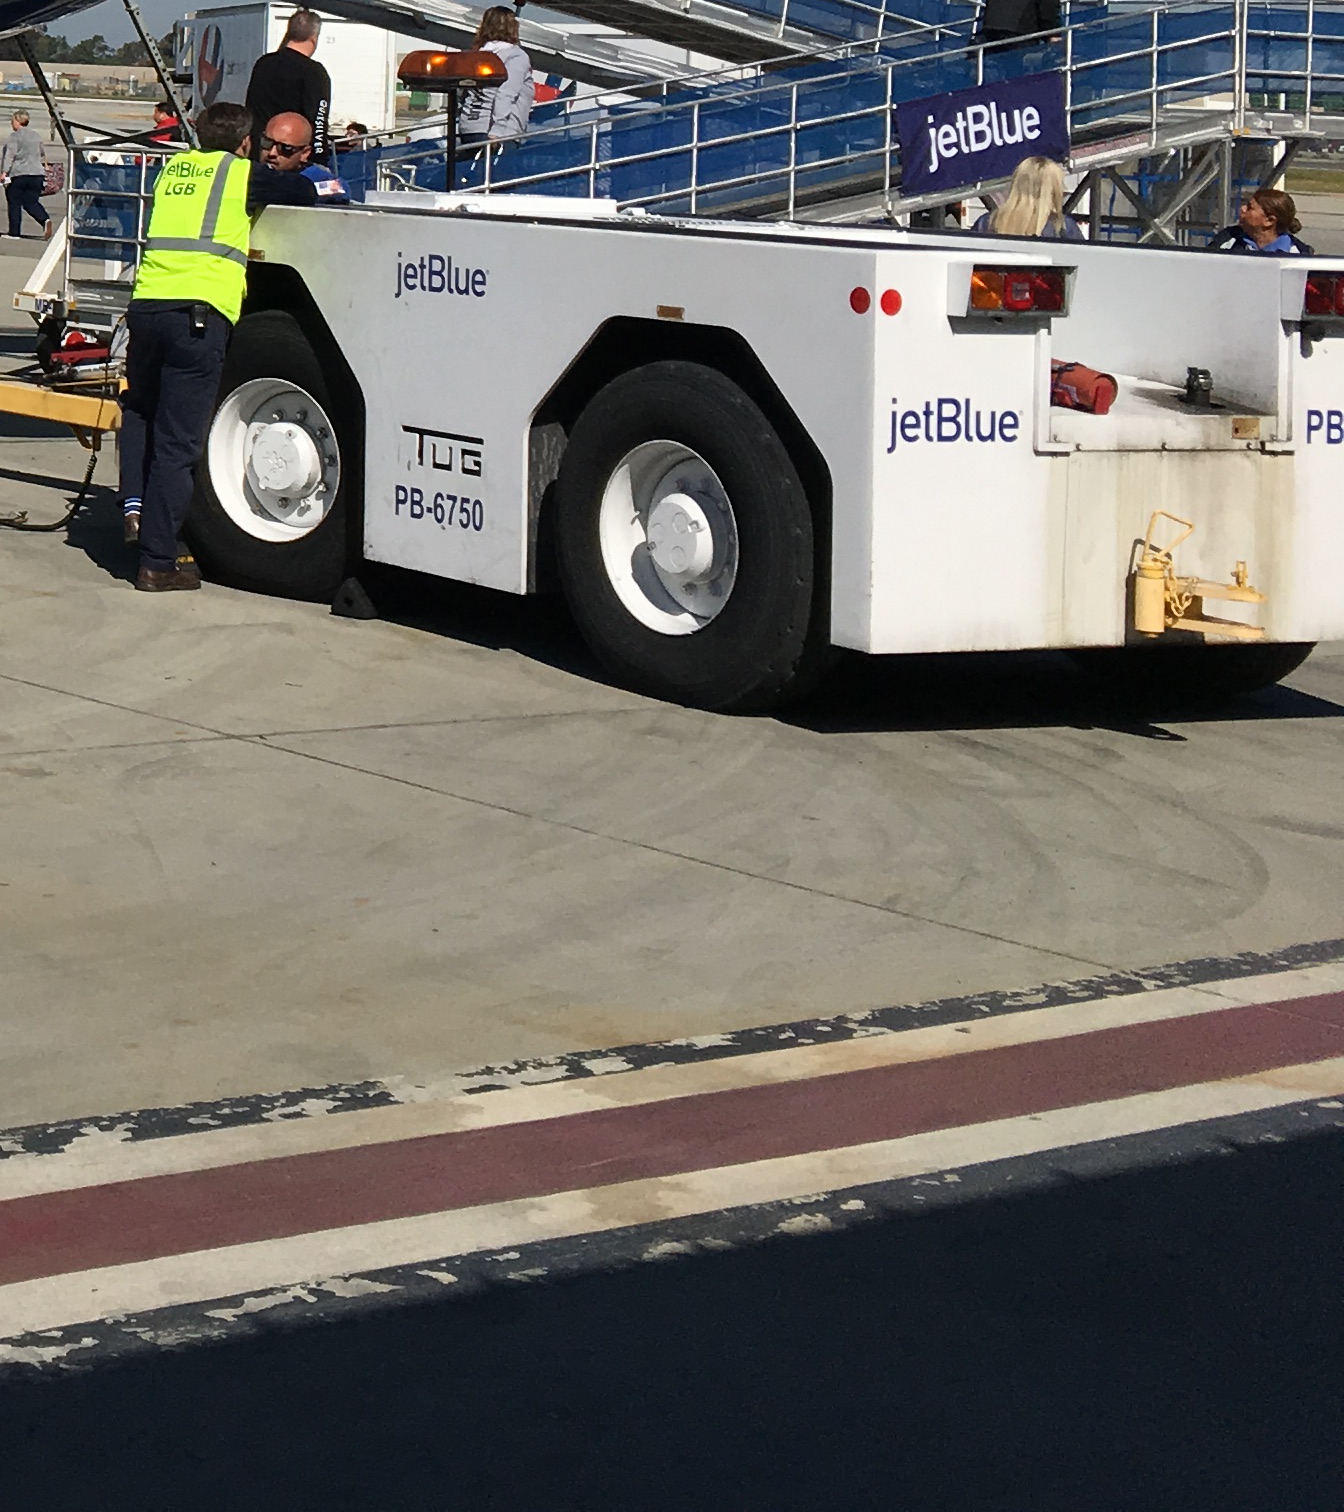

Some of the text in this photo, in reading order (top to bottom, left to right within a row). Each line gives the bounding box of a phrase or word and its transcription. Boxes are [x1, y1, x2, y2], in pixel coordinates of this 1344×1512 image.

[927, 101, 1041, 173] jetBlue
[164, 181, 197, 196] LGB
[394, 251, 487, 299] jetBlue
[401, 424, 484, 478] TUG
[886, 397, 1020, 455] jetBlue
[395, 484, 484, 532] PB-6750
